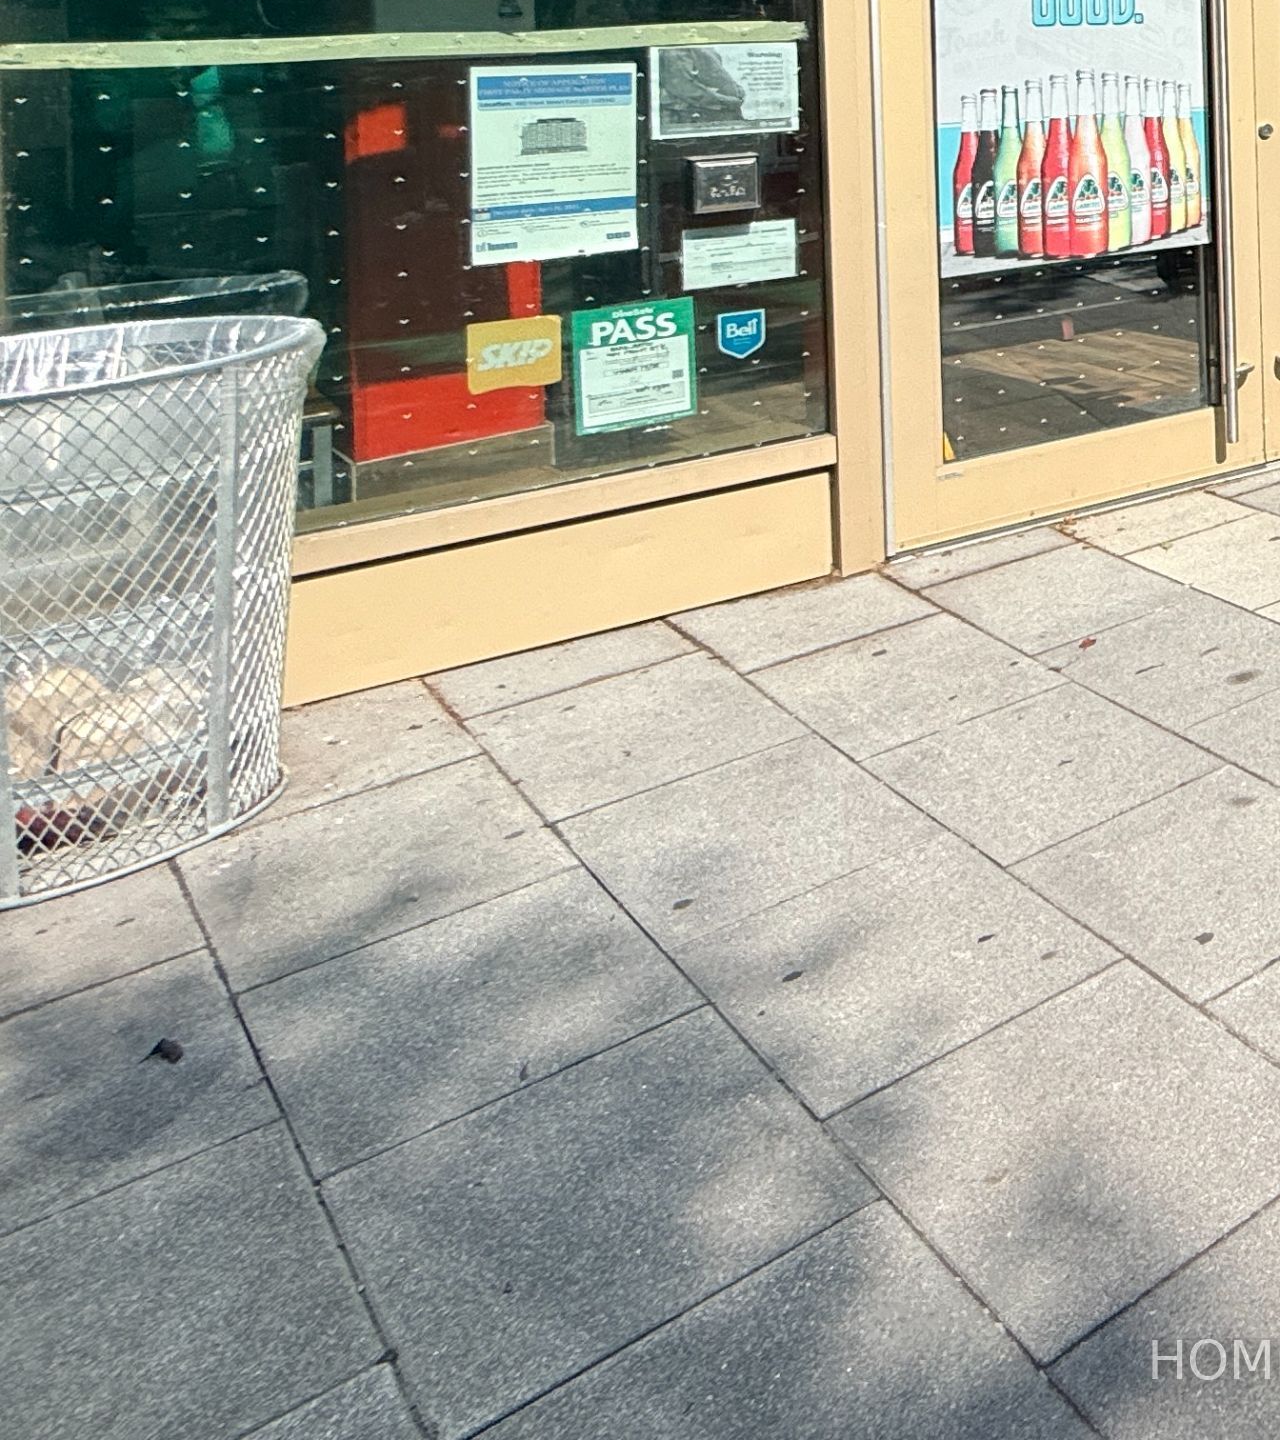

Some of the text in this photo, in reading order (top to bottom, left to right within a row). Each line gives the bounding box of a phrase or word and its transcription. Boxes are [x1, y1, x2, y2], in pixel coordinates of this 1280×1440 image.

[612, 306, 655, 319] DineSafe
[588, 312, 678, 347] PASS
[725, 317, 758, 339] Bell
[476, 338, 553, 372] SKIP
